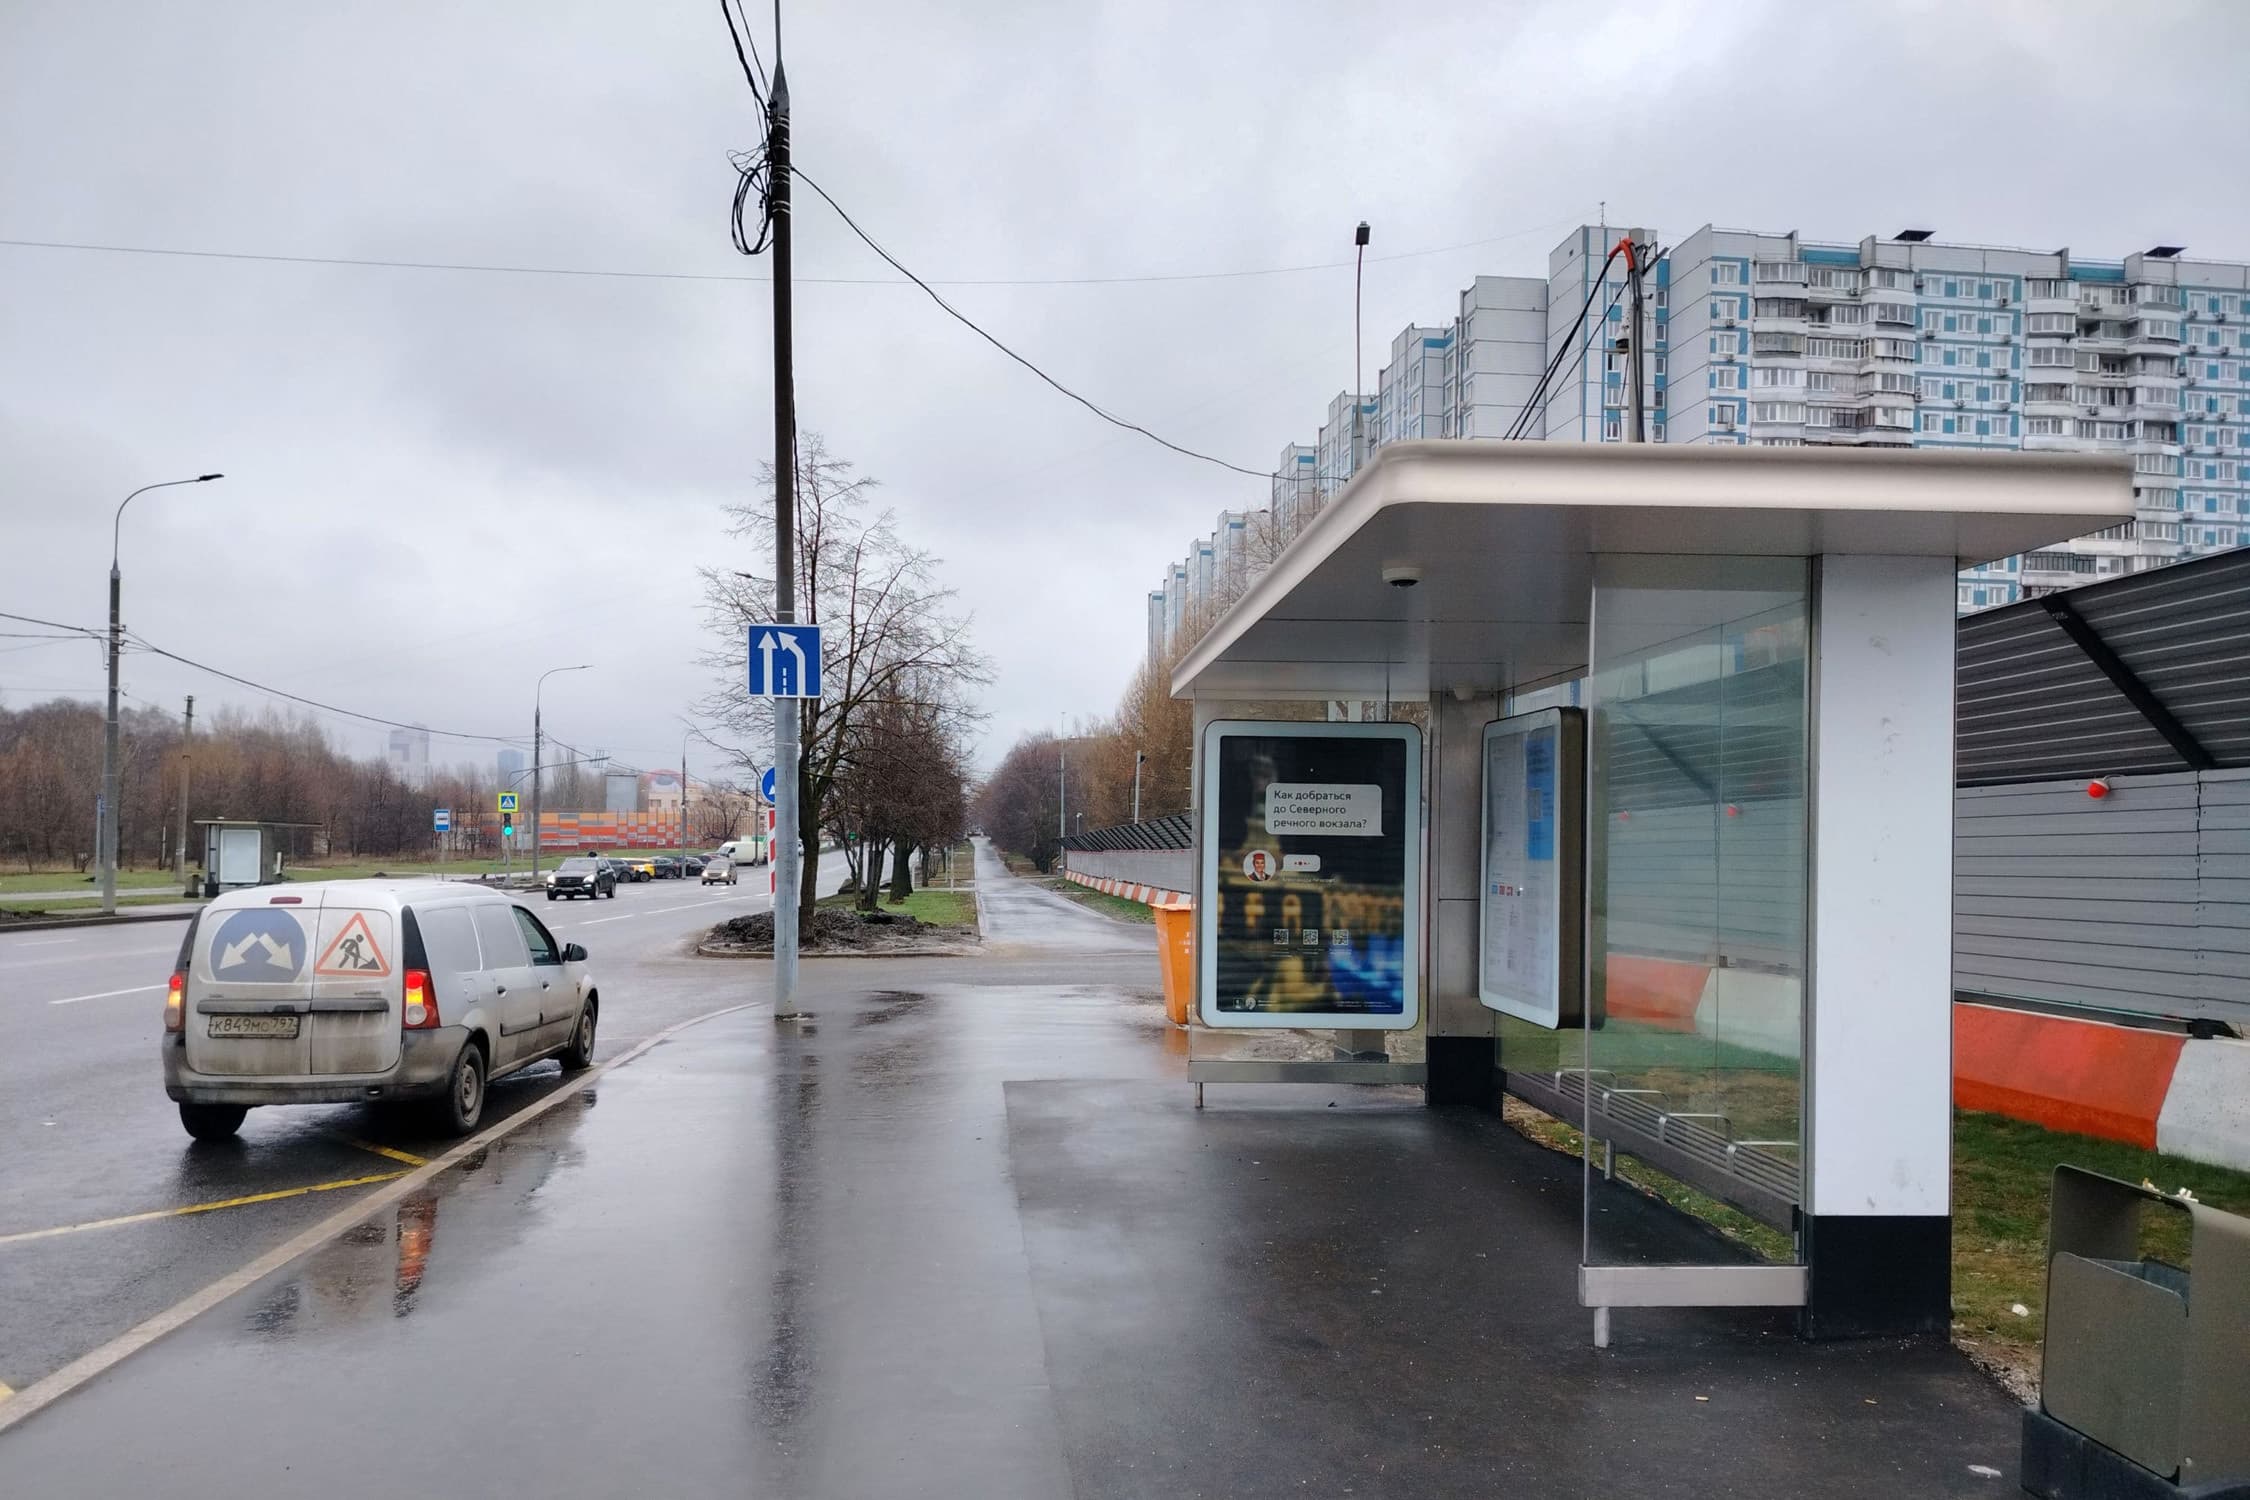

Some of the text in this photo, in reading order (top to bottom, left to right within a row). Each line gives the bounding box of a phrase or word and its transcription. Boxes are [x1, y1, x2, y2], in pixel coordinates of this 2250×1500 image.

[1274, 790, 1351, 801] Как добраться
[1273, 804, 1346, 815] до Северного
[1273, 818, 1367, 829] речного вокзала?
